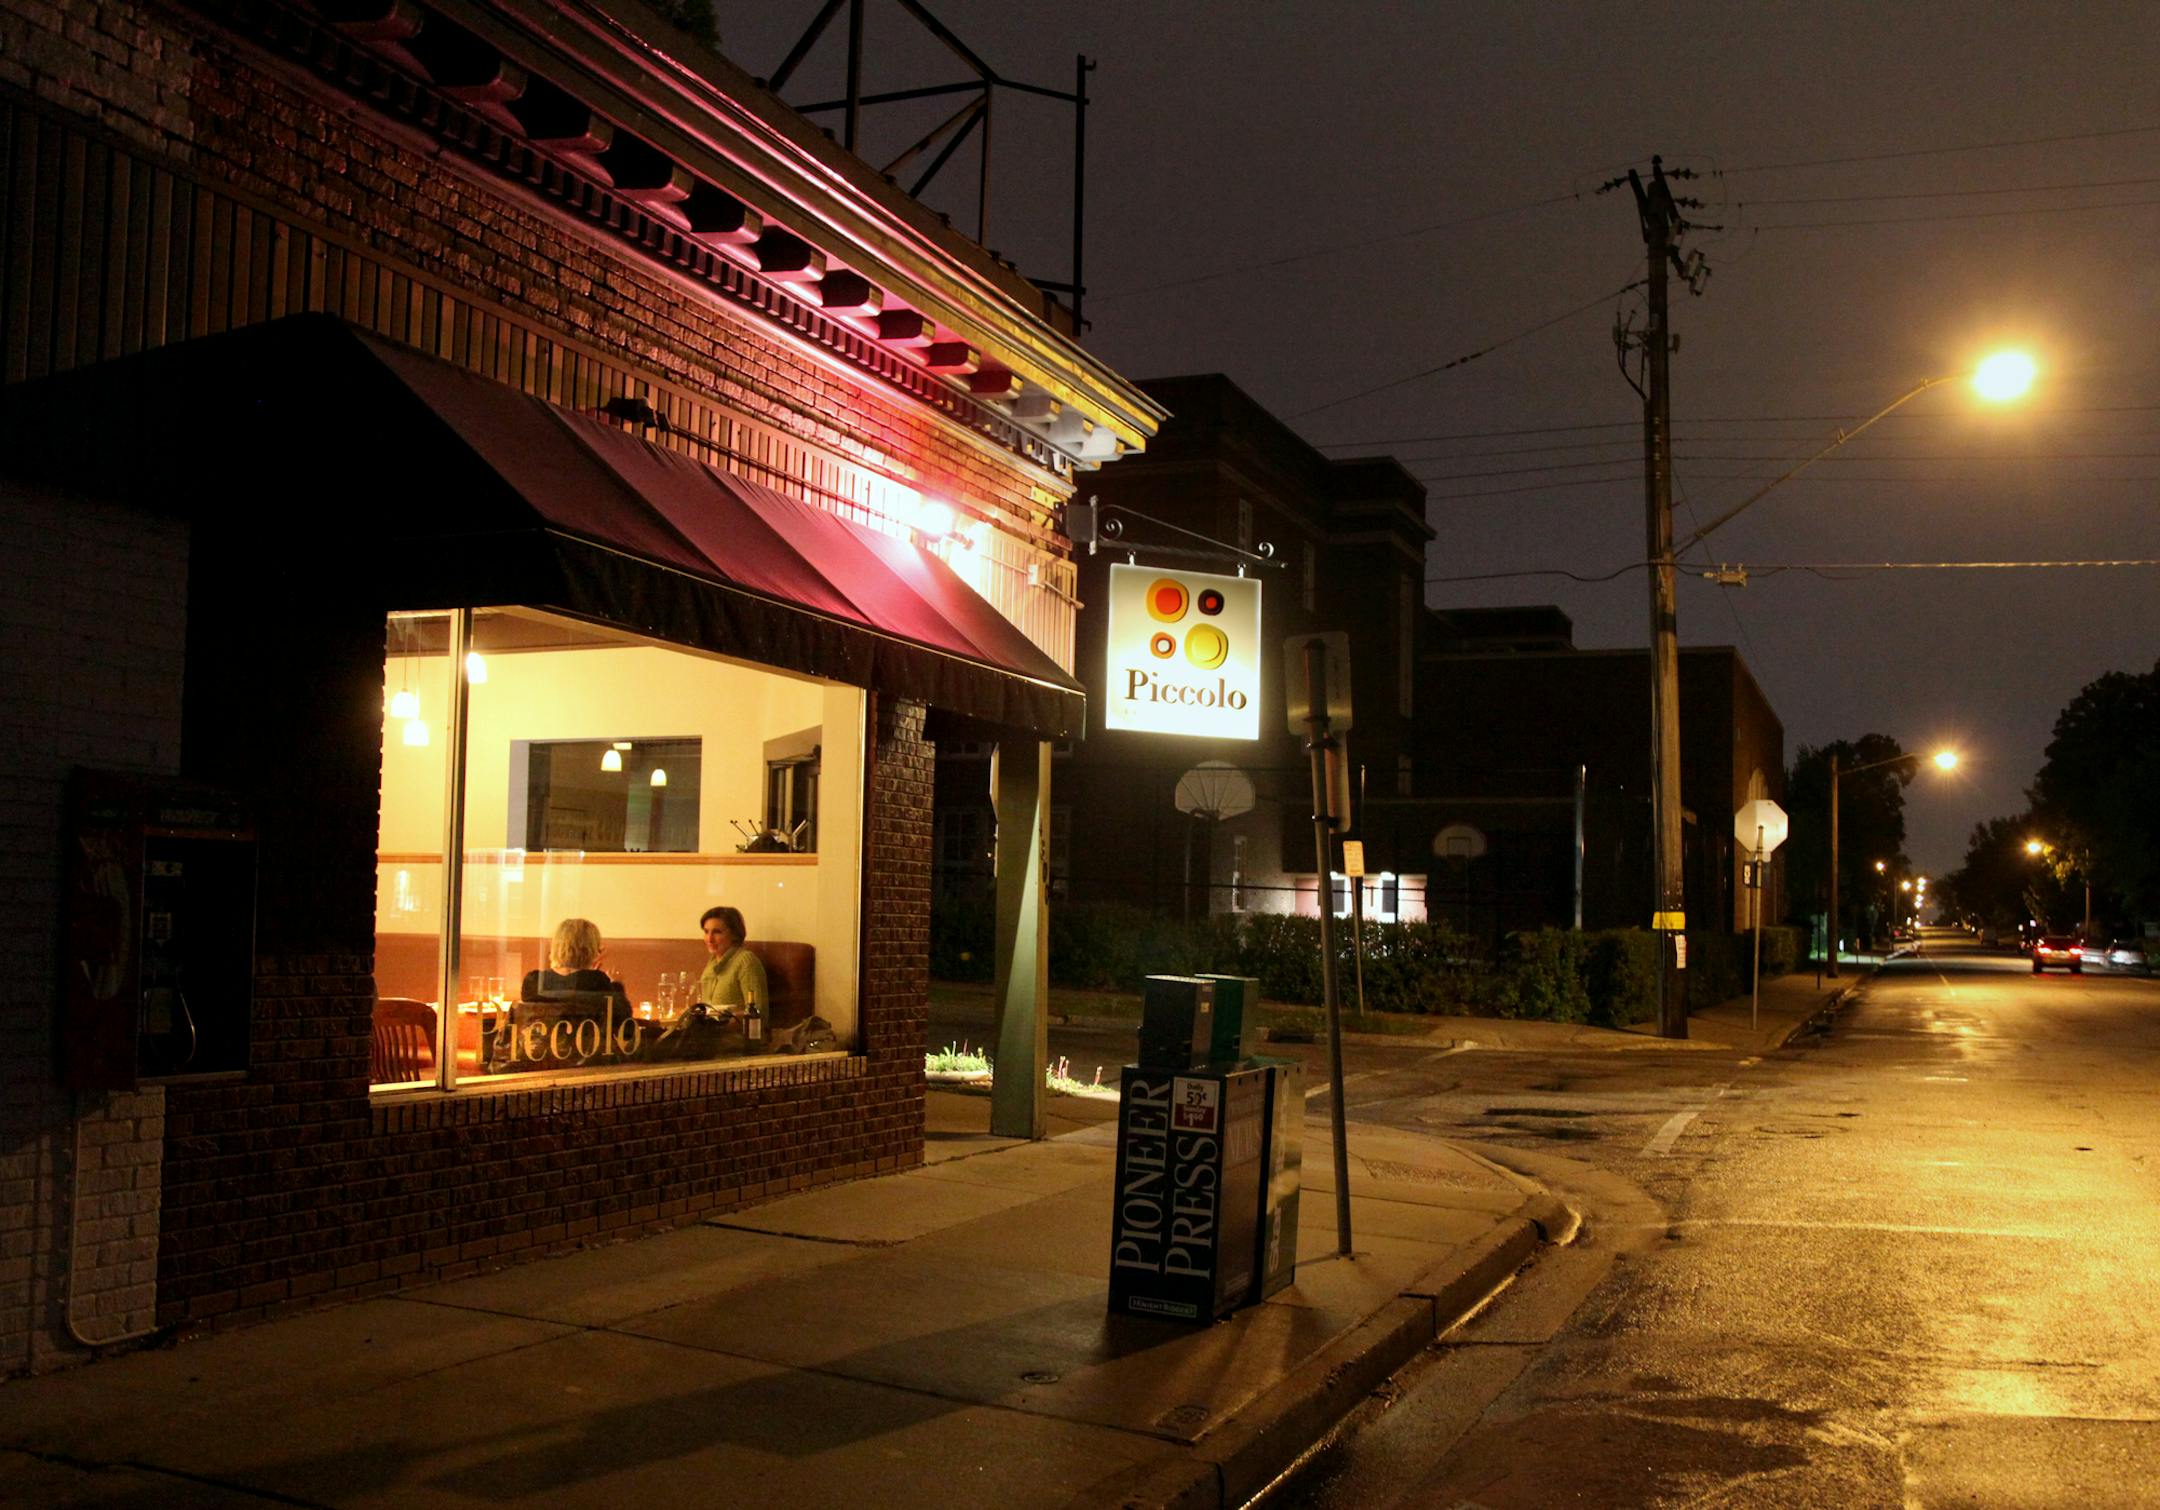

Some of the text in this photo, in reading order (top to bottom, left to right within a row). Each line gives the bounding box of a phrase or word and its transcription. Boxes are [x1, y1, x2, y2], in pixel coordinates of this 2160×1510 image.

[1124, 668, 1248, 711] Piccolo
[475, 995, 642, 1065] Piccolo
[1115, 1079, 1170, 1273] PIONEER
[1164, 1135, 1218, 1279] PRESS
